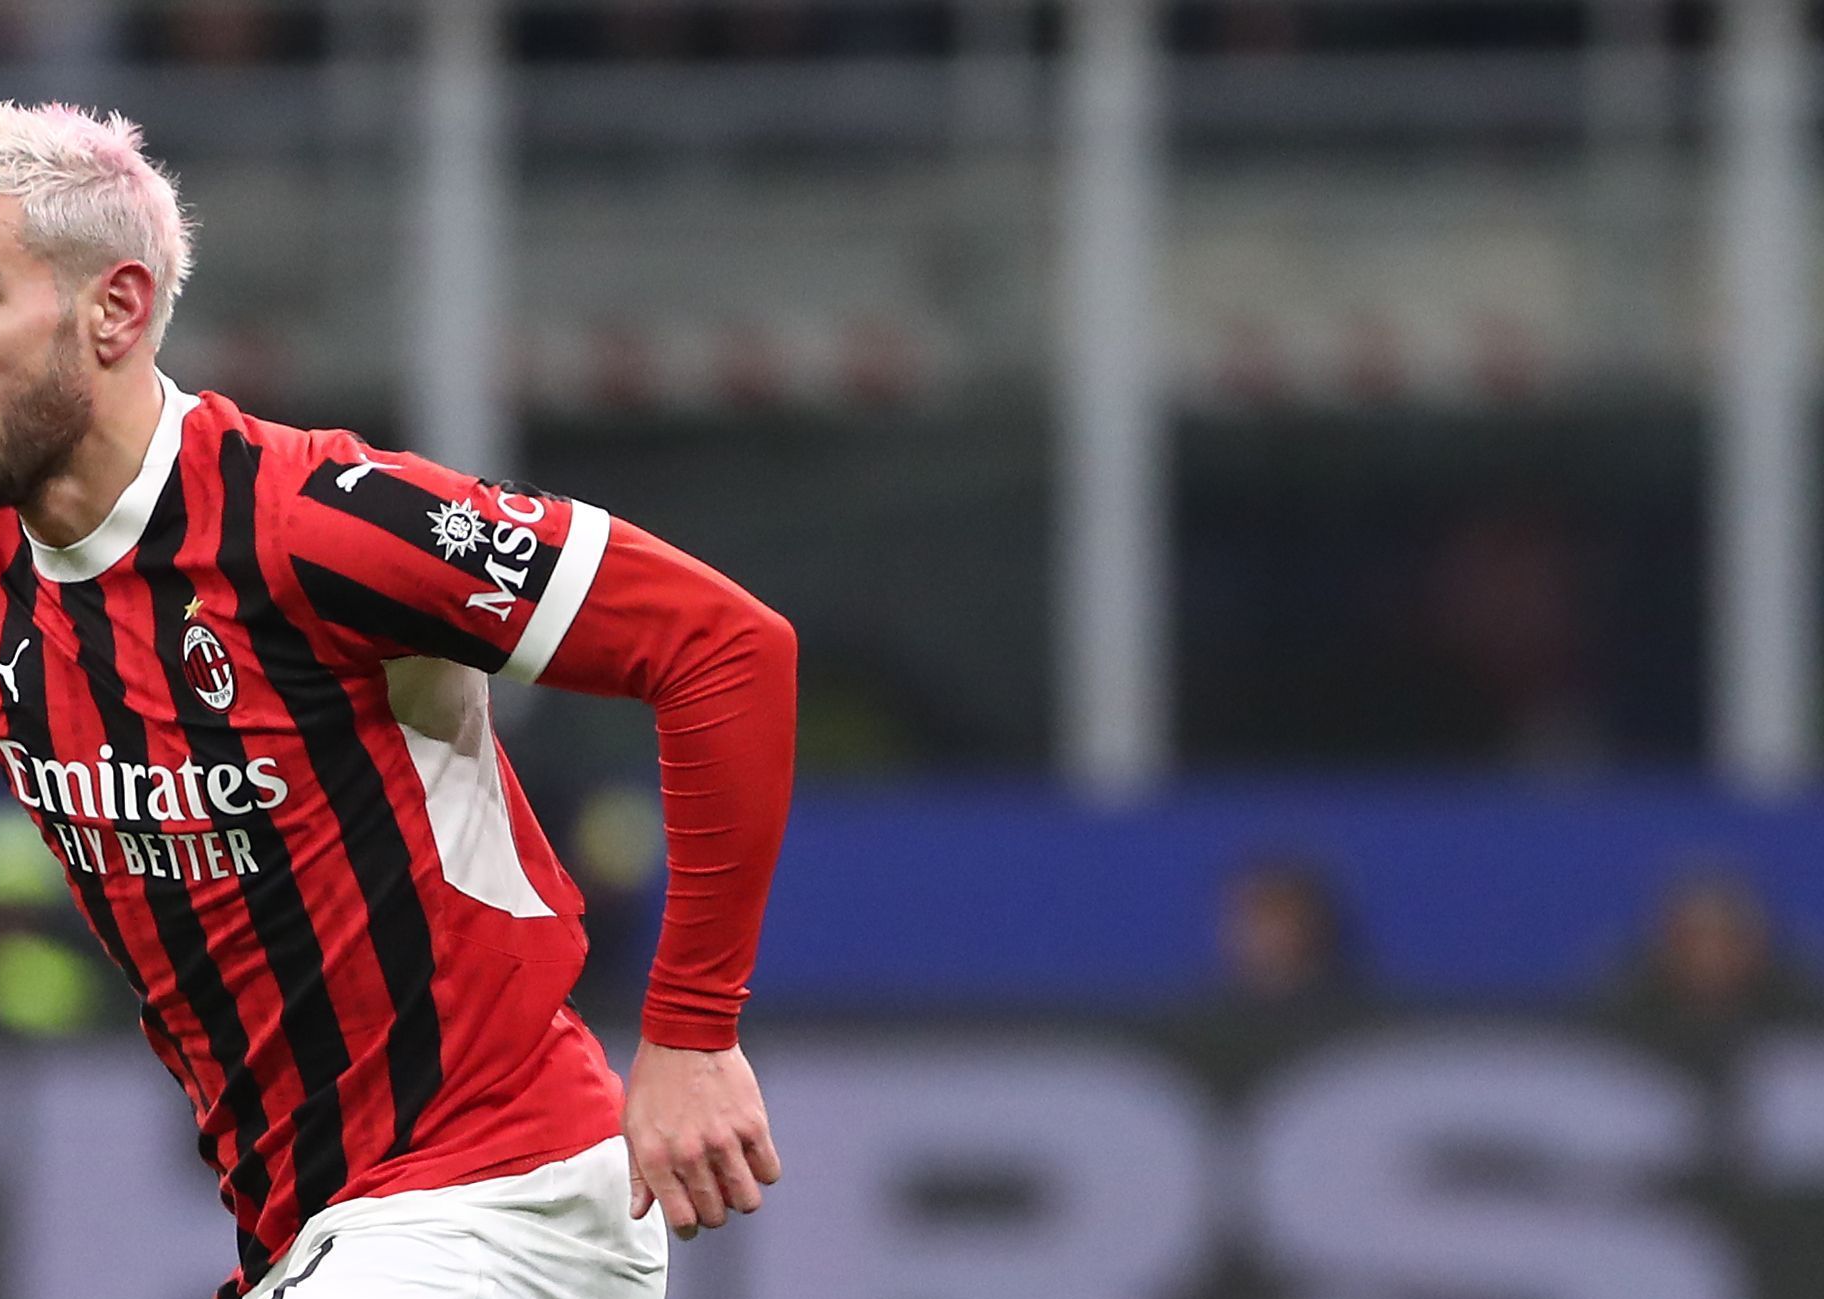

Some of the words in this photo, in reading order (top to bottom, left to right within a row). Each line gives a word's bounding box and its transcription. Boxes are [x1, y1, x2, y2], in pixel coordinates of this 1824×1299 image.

[465, 490, 545, 622] MSC
[208, 690, 231, 703] 1899
[53, 822, 108, 876] FLY
[114, 828, 259, 881] BETTER
